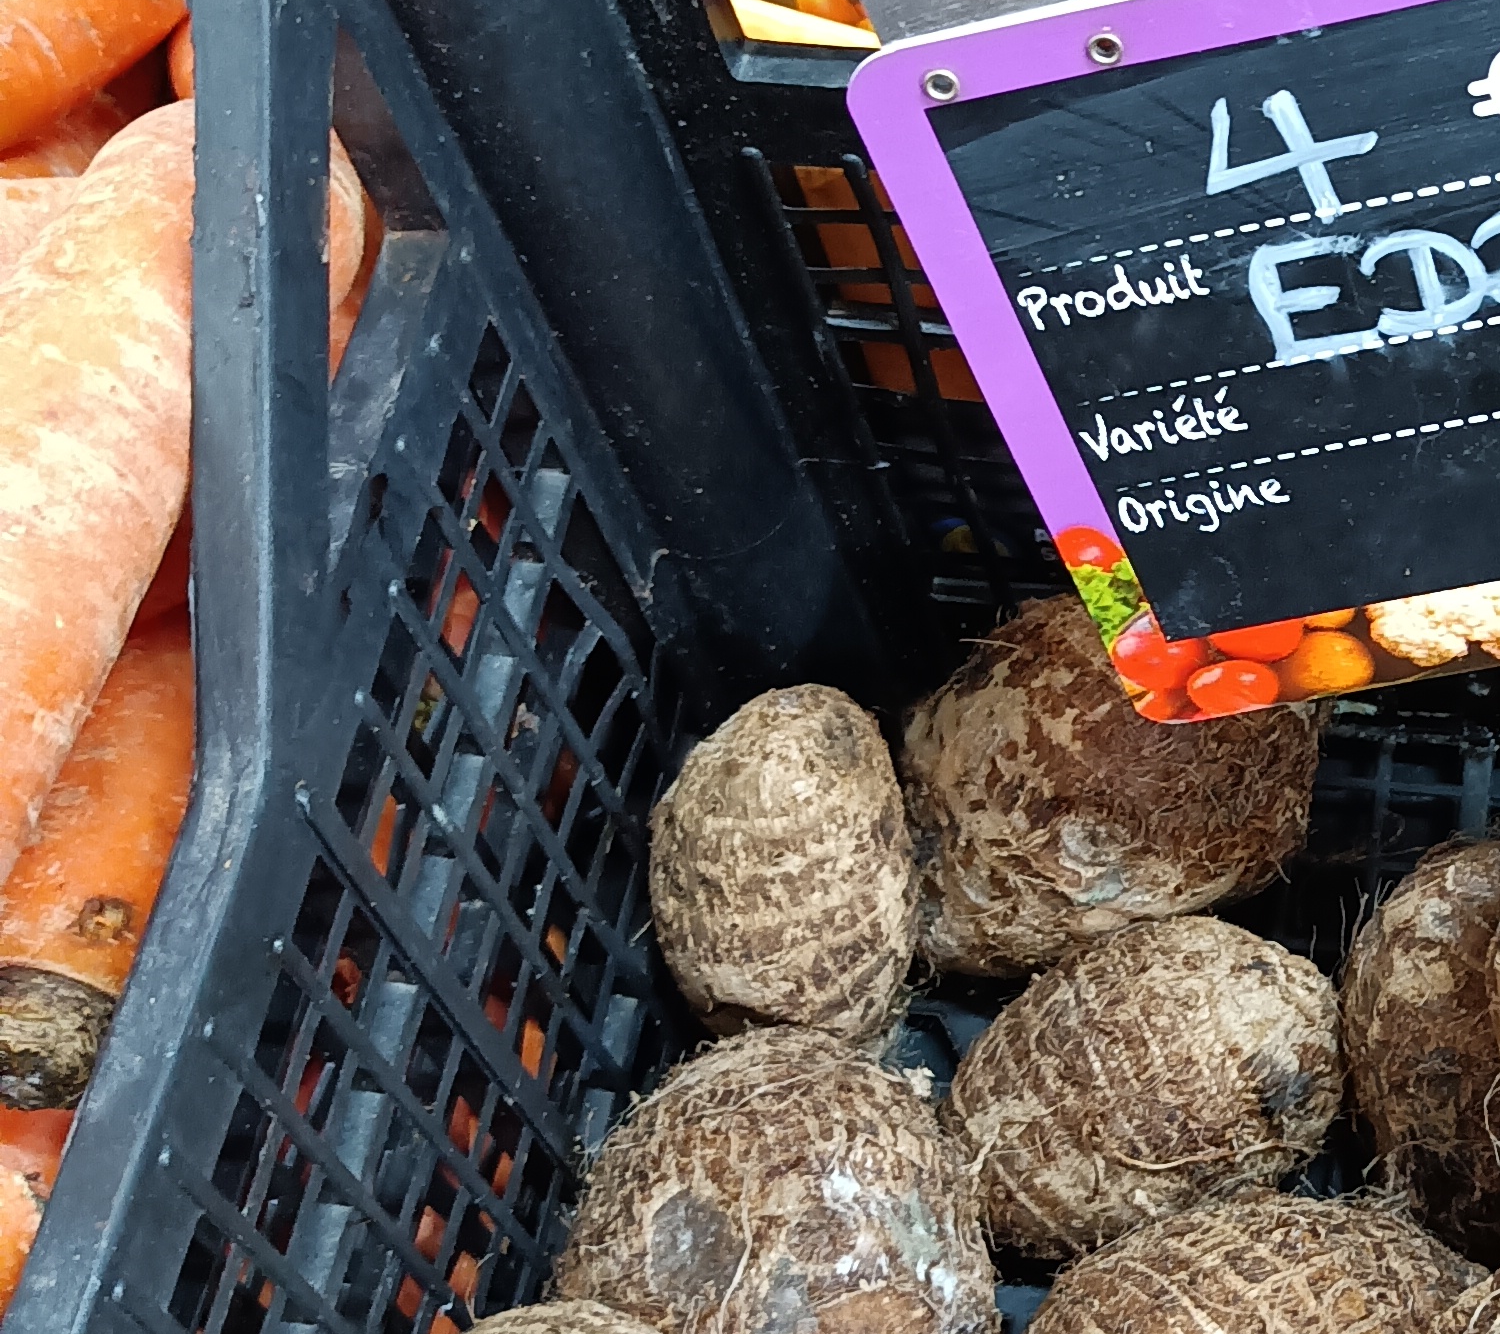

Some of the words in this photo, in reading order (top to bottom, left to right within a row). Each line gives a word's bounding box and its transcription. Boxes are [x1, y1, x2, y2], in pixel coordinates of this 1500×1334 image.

[1206, 89, 1380, 223] 4
[1017, 253, 1211, 331] Produit
[1078, 385, 1249, 461] Variété
[1117, 478, 1291, 533] Origine
